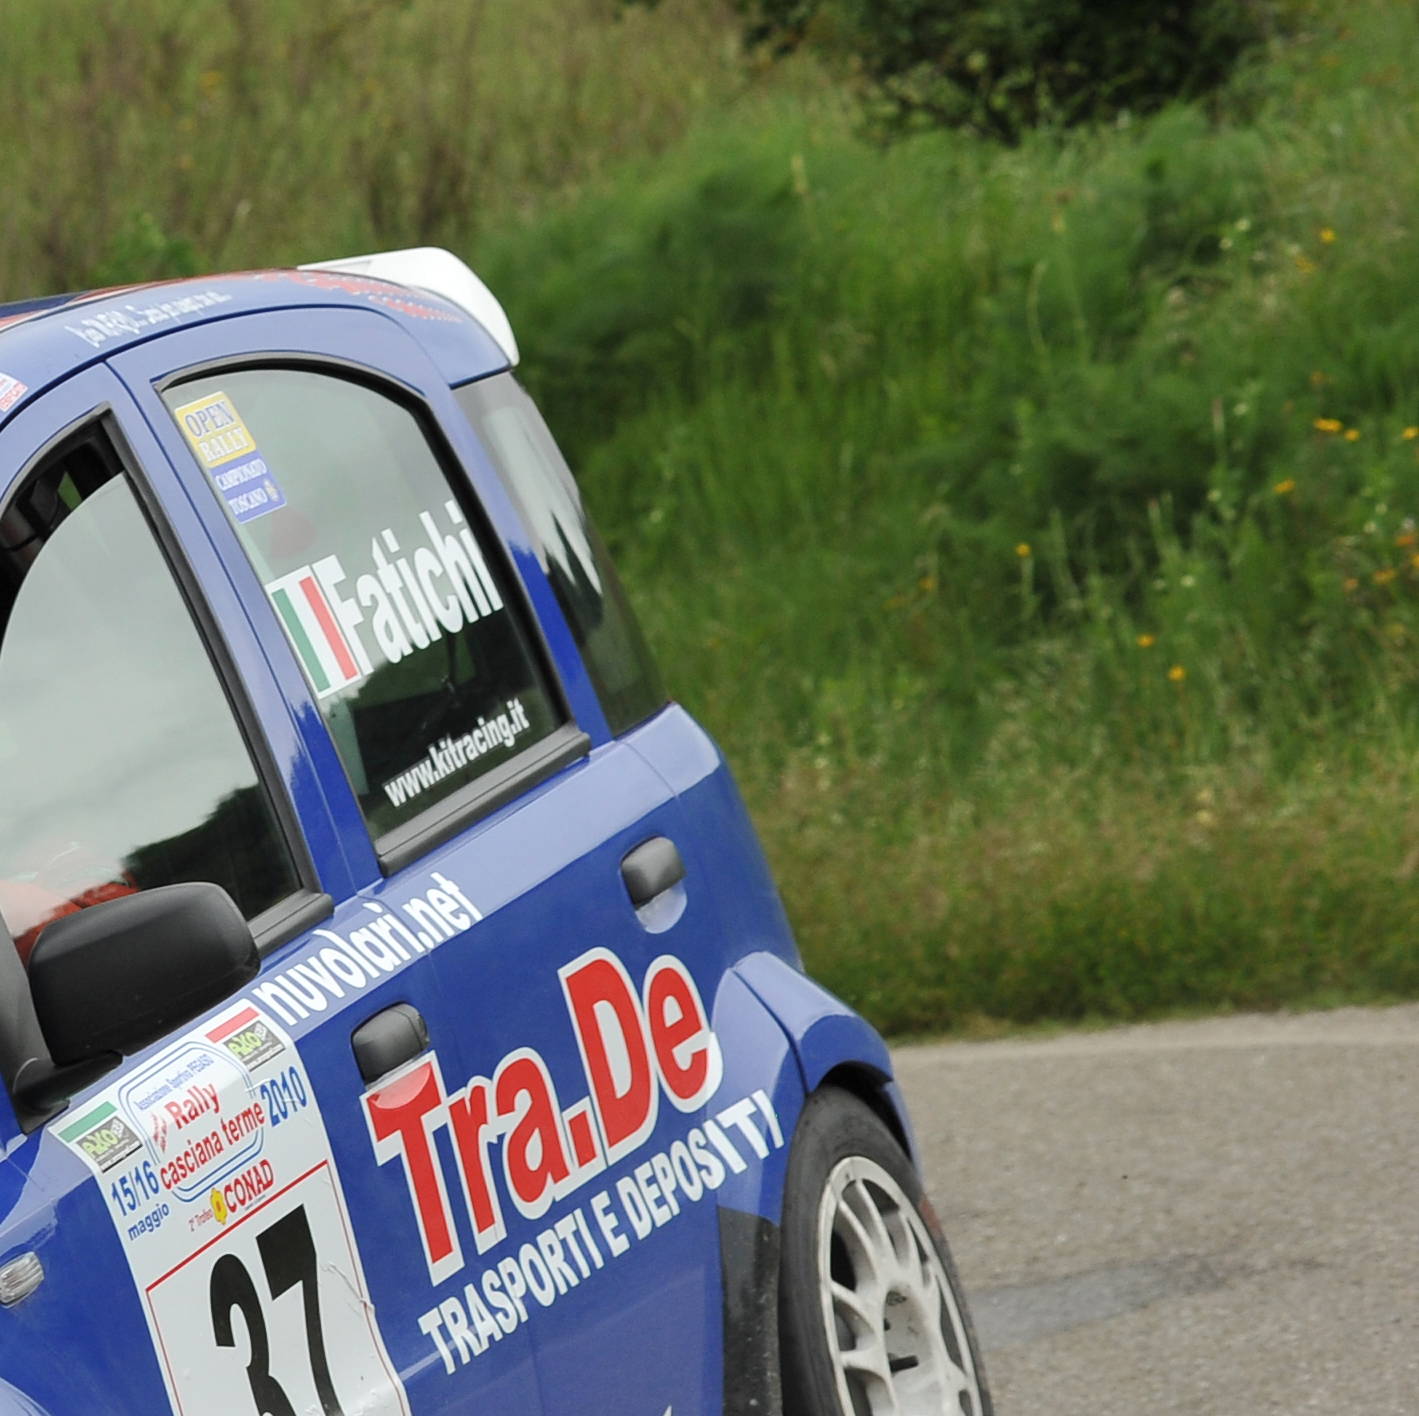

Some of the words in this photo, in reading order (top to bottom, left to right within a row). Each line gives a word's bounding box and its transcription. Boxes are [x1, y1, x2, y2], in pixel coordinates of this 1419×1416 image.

[184, 401, 236, 438] OPEN
[197, 427, 250, 463] RALLY
[312, 500, 505, 673] Fatichi
[383, 697, 531, 808] www.kitracing.it
[253, 872, 485, 1026] nuvolari.net
[164, 1083, 221, 1130] Rally
[259, 1066, 307, 1127] 2010
[359, 946, 723, 1287] Tra.De
[159, 1130, 225, 1190] casciana
[220, 1101, 266, 1146] terme
[111, 1160, 161, 1217] 15/16
[223, 1159, 275, 1214] CONAD
[127, 1202, 171, 1241] maggio
[418, 1217, 605, 1375] TRASPORTI
[587, 1190, 630, 1257] E
[618, 1089, 786, 1244] DEPOSITI
